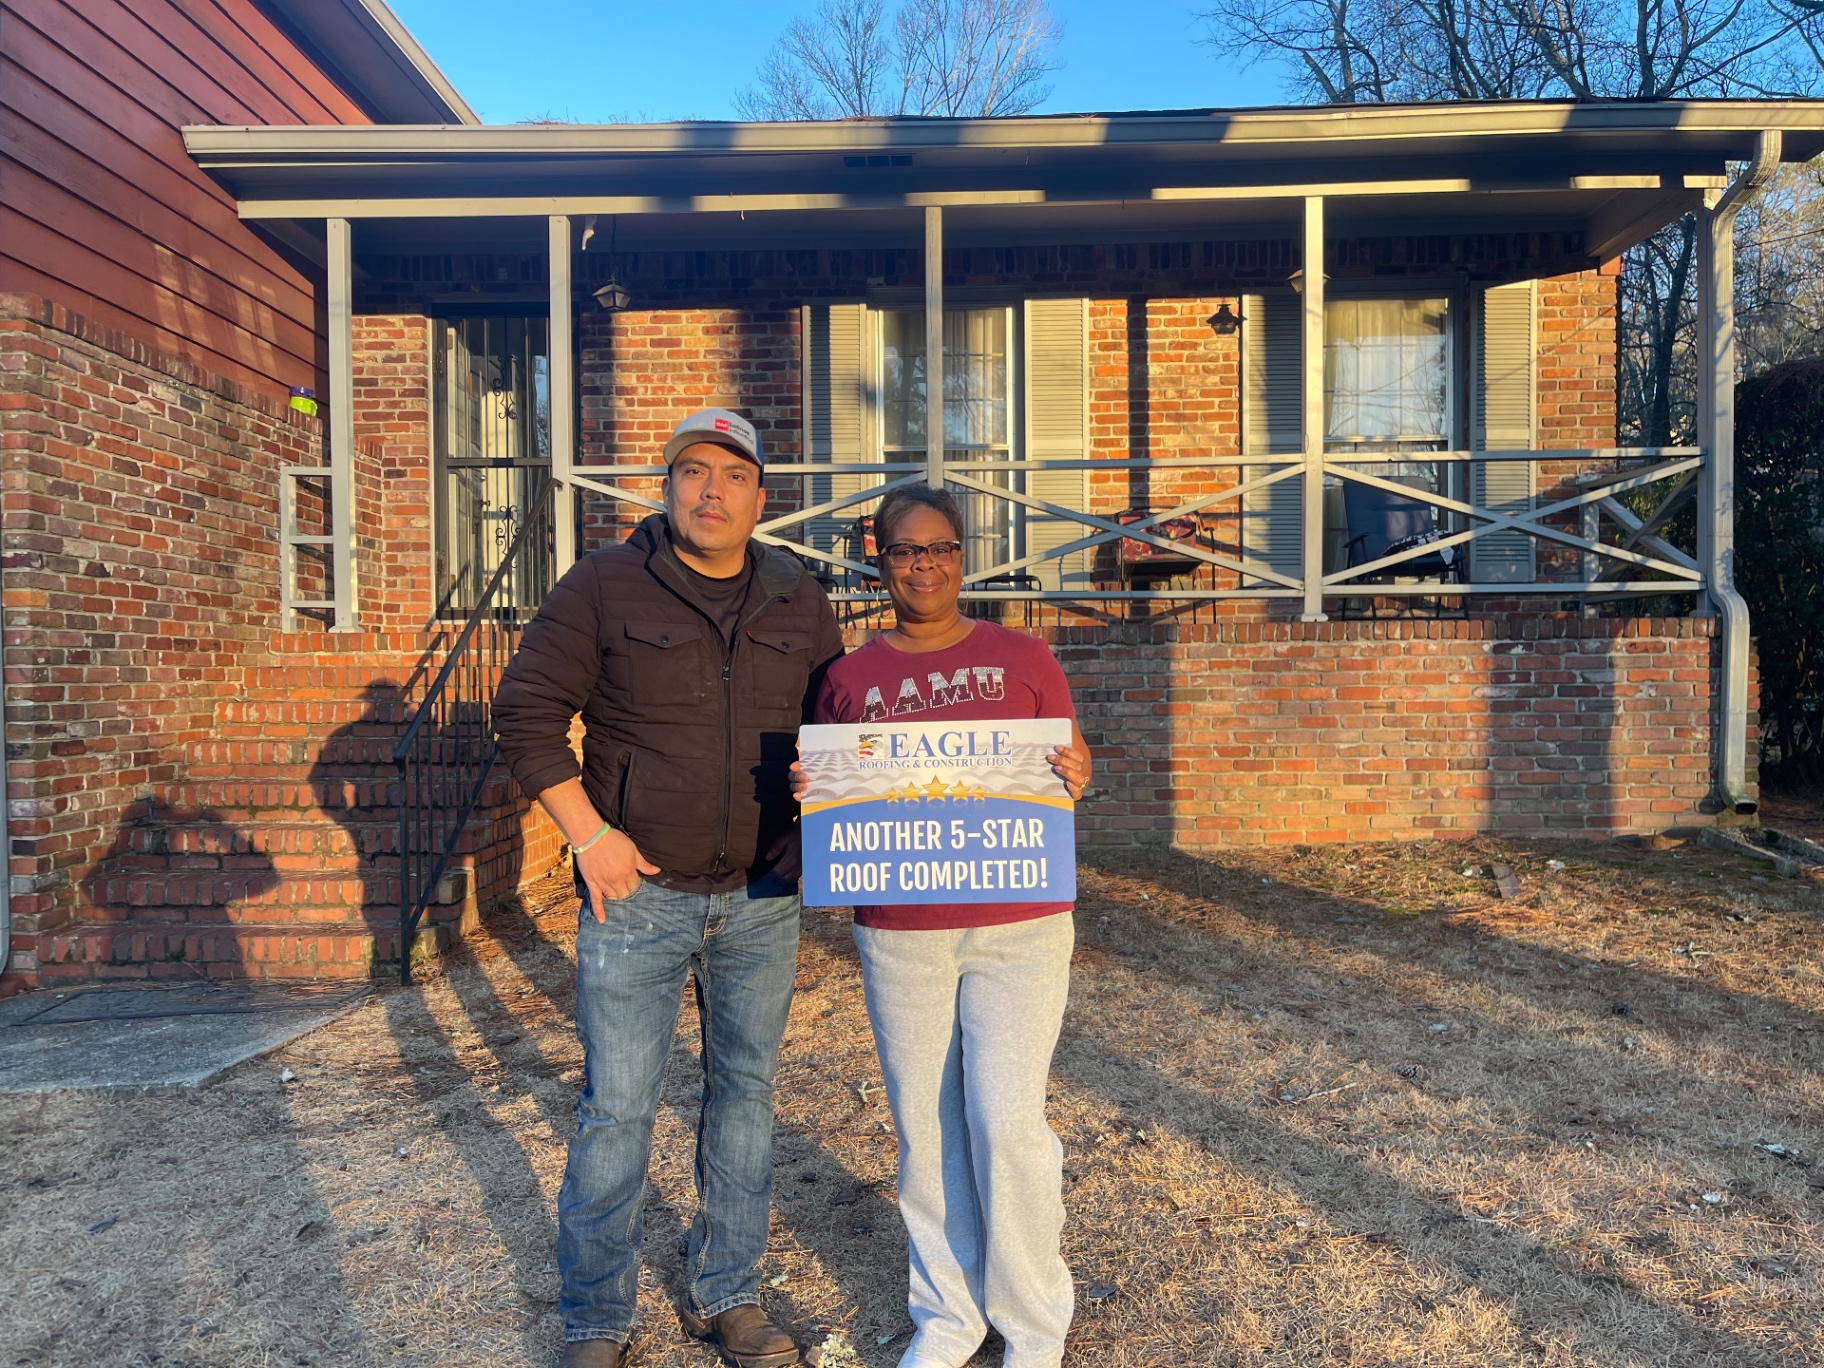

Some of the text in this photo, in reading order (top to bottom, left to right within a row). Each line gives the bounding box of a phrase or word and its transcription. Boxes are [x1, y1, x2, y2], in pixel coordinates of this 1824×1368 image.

[860, 666, 1005, 723] AAMU
[888, 731, 1012, 758] EAGLE
[859, 758, 1012, 769] ROOFING & CONSTRUCTION
[830, 818, 1045, 852] ANOTHER 5-STAR
[829, 858, 1048, 893] ROOF COMPLETED!
